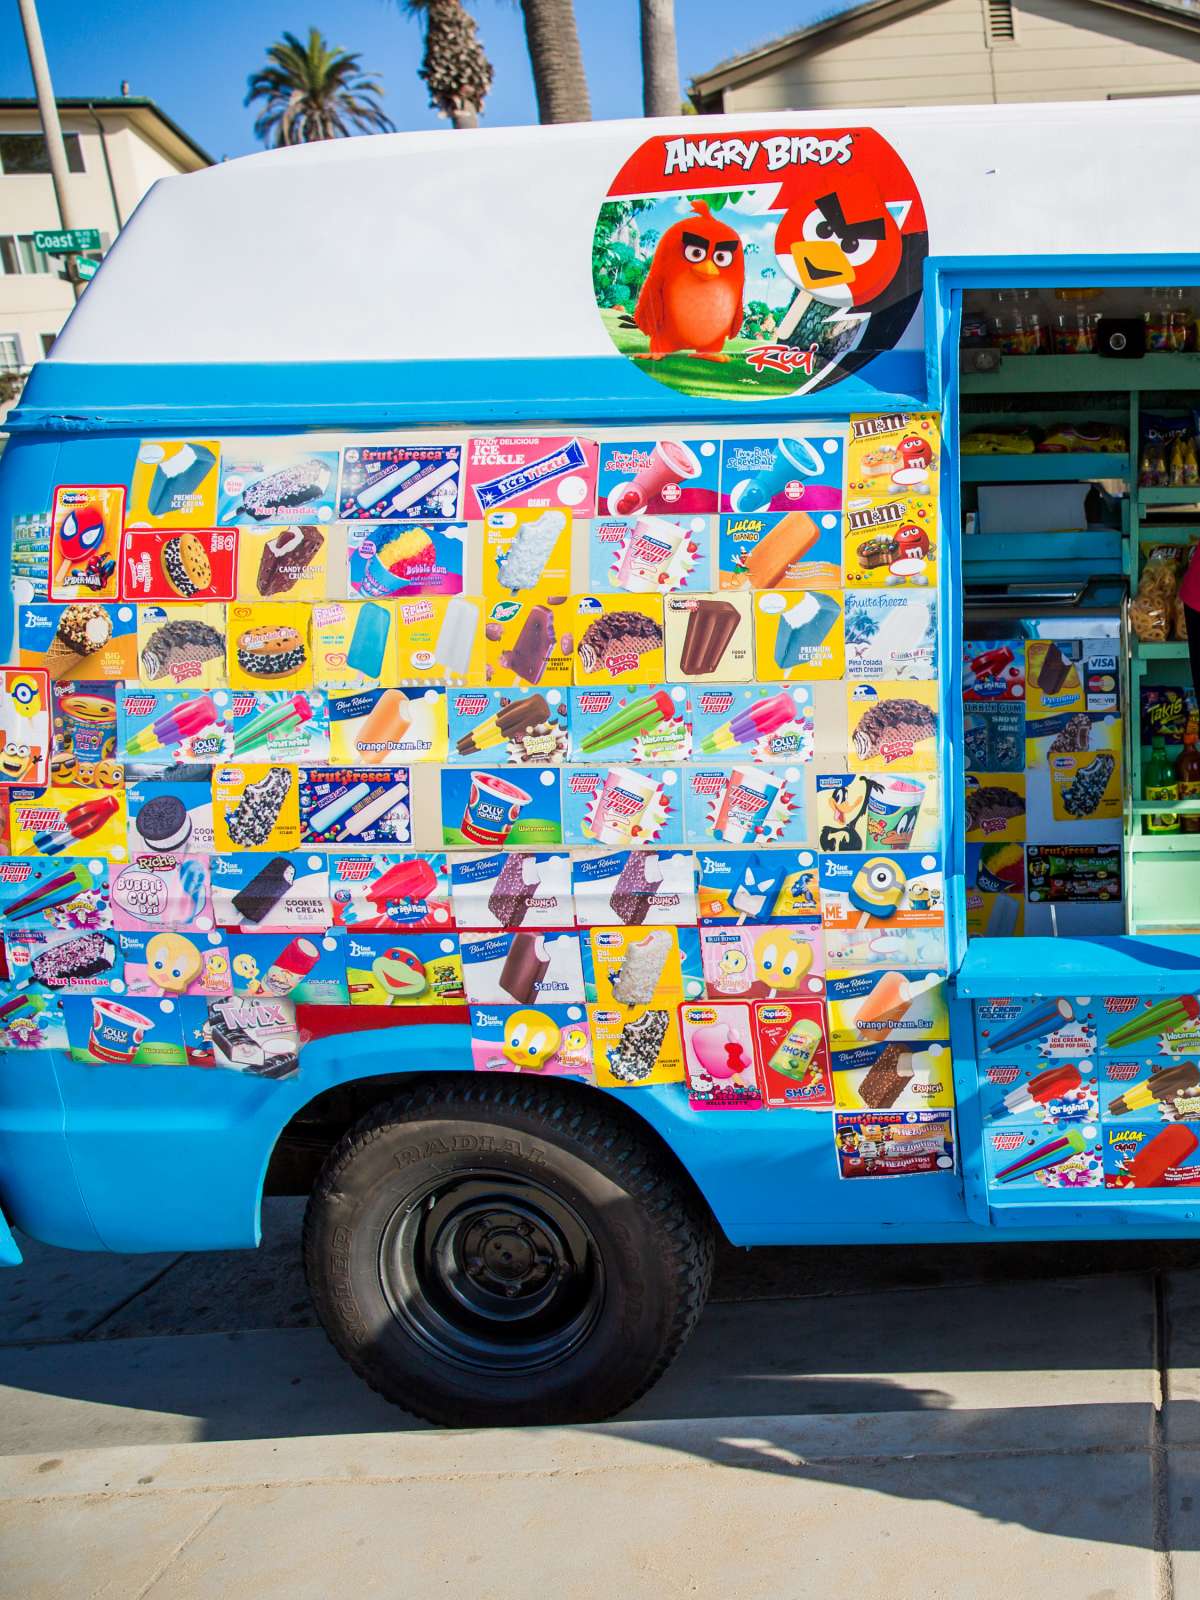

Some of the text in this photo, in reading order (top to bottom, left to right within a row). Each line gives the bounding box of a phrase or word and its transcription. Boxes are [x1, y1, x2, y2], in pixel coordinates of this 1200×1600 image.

[664, 134, 853, 175] ANGRY BIRDS
[36, 234, 73, 248] Coast
[474, 446, 500, 455] ICE
[612, 450, 648, 461] Two Ball
[734, 448, 773, 458] Two Ball
[471, 454, 525, 465] TICKLE
[501, 454, 569, 493] ICE TICKLE
[183, 500, 205, 508] CREAM
[528, 498, 550, 506] GIANT
[255, 507, 317, 515] Nut Sundae
[726, 518, 766, 535] Lucas
[733, 533, 759, 542] MANGO
[431, 565, 447, 575] Gum
[63, 575, 102, 588] SPIDER-MAN
[1089, 658, 1115, 668] VISA
[123, 698, 155, 716] BOMB POP
[336, 700, 352, 711] Blue
[354, 696, 374, 706] Ribbon
[455, 698, 489, 716] BOMB POP
[577, 695, 614, 714] BOMB POP
[699, 696, 735, 713] BOMB POP
[1148, 698, 1183, 724] Takis
[75, 734, 102, 745] emoji
[76, 742, 90, 750] ice
[193, 737, 218, 747] JOLLY
[357, 740, 432, 751] Orange Dream Bar
[771, 735, 797, 746] JOLLY
[569, 776, 602, 793] BOMB POP
[695, 785, 721, 794] POP
[19, 808, 61, 821] BOMB
[478, 802, 504, 815] JOLLY
[23, 820, 52, 832] POP
[138, 855, 176, 869] Rich's
[335, 861, 375, 881] BOMB POP
[116, 878, 163, 891] BUBBLE
[127, 891, 159, 906] GUM
[525, 897, 557, 907] CRUNCH
[647, 895, 680, 905] CRUNCH
[825, 906, 843, 920] ME
[47, 977, 109, 985] Nut Sundae
[1104, 997, 1140, 1014] BOMB POP
[213, 999, 288, 1030] TWIX
[857, 1019, 933, 1029] Orange Dream Bar
[102, 1025, 128, 1037] JOLLY
[782, 1045, 810, 1060] SHOTS
[985, 1067, 1021, 1085] BOMB POP
[1105, 1064, 1141, 1082] BOMB POP
[784, 1084, 826, 1098] SHOTS
[912, 1083, 944, 1093] CRUNCH
[1048, 1101, 1091, 1116] Original
[991, 1135, 1027, 1151] BOMB POP
[1109, 1130, 1146, 1145] Lucas
[392, 1134, 548, 1170] RADIAL
